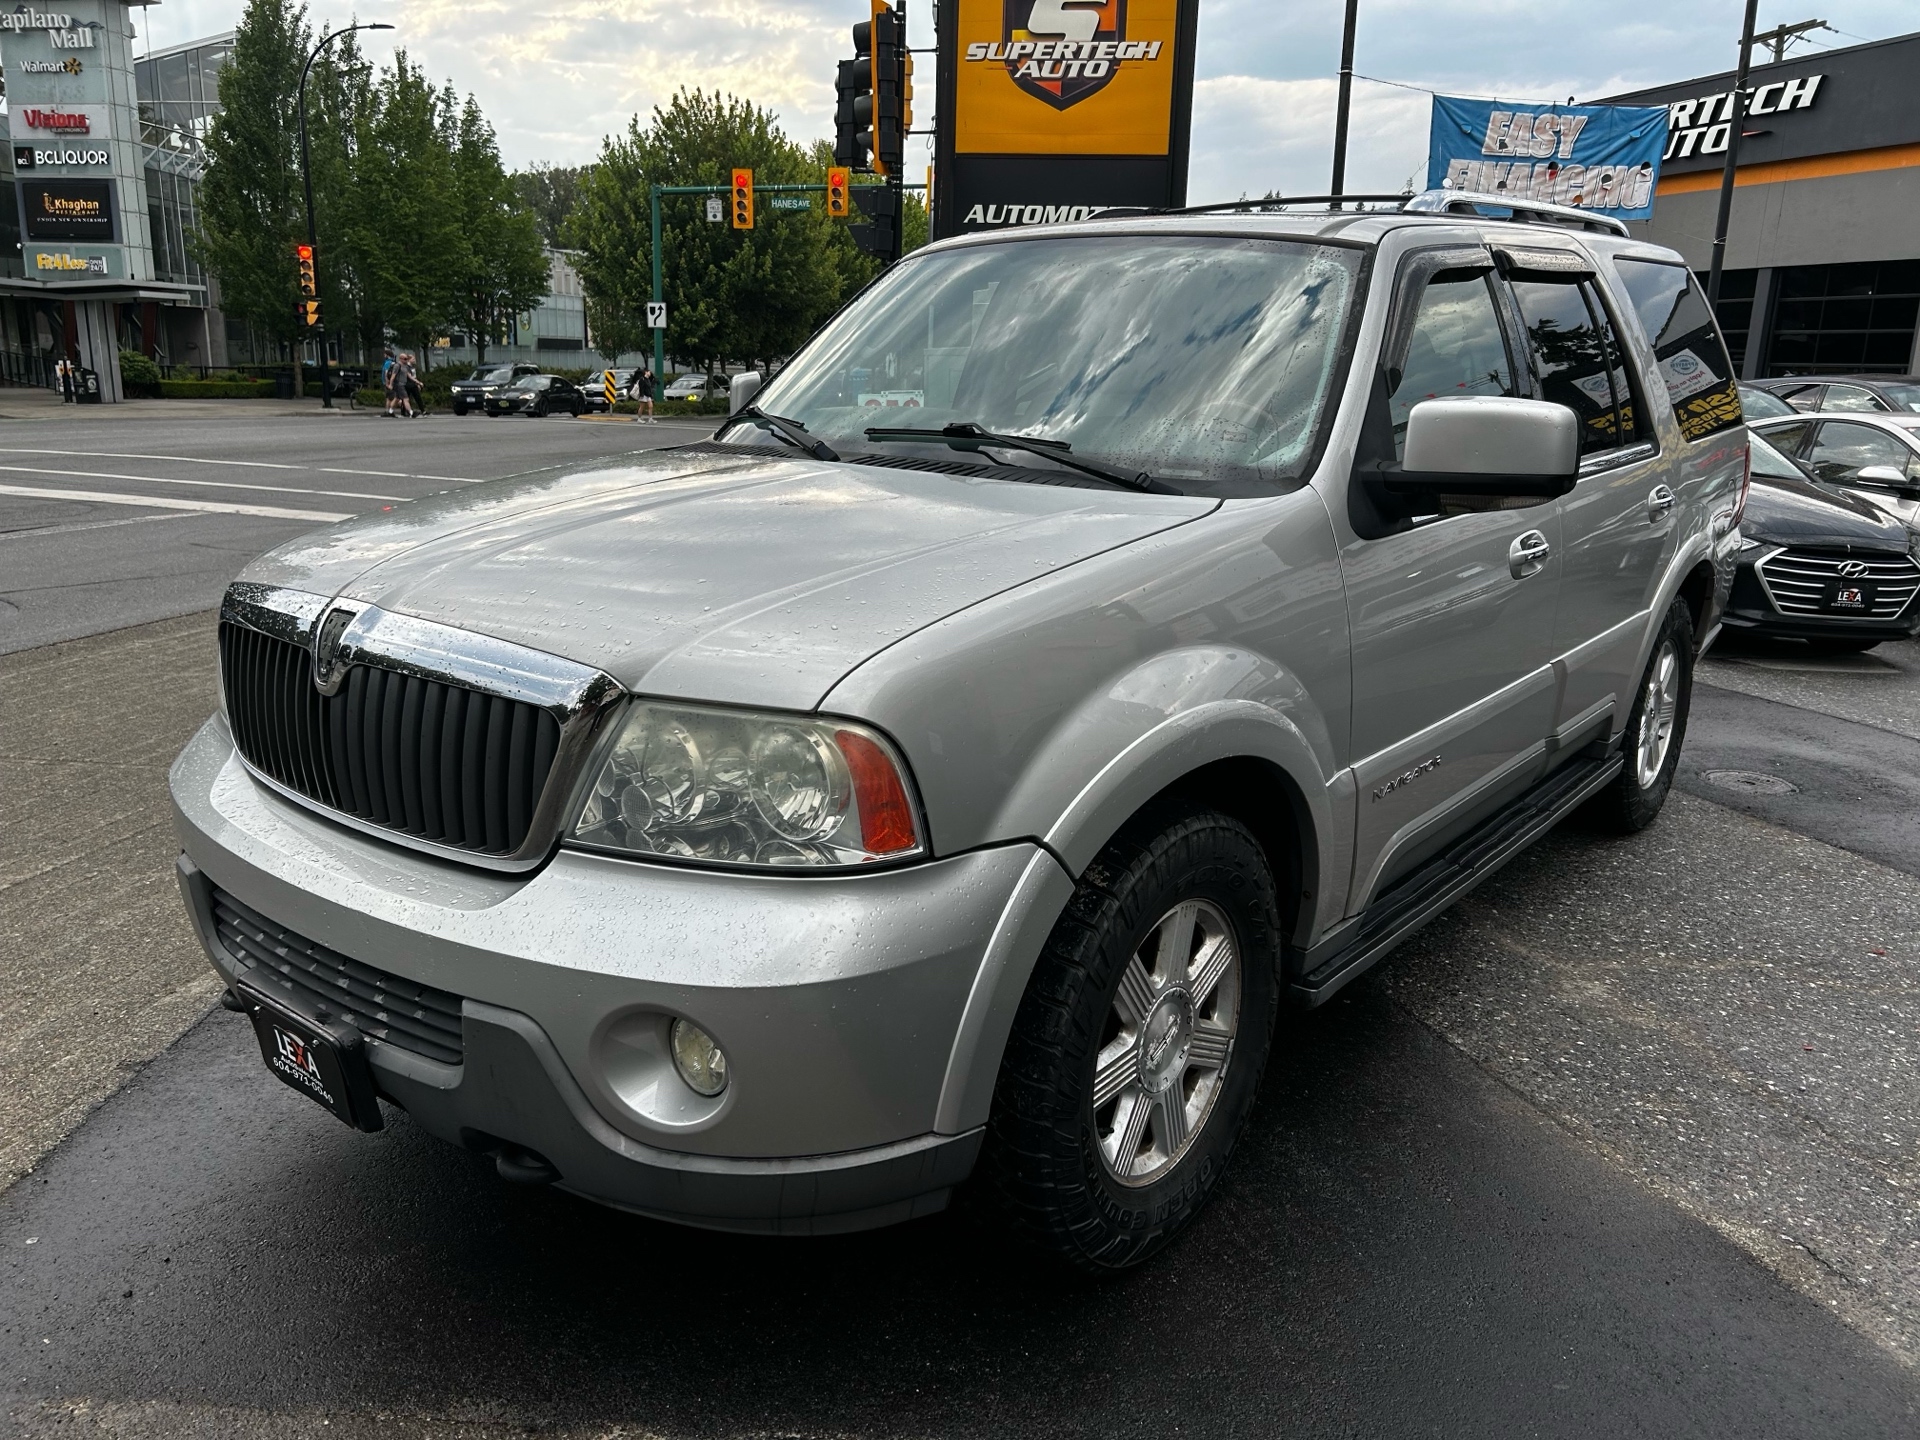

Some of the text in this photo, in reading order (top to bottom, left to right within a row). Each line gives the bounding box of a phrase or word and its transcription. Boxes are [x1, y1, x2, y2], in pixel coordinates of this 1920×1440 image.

[47, 27, 95, 49] Mall
[965, 40, 1162, 61] SUPERTECH
[20, 60, 66, 73] Walmart
[1013, 60, 1109, 79] AUTO
[1482, 110, 1588, 160] EASY
[54, 198, 100, 211] Khaghan
[771, 199, 811, 209] HANES AVE
[963, 203, 1140, 225] AUTOMO
[1837, 590, 1862, 602] LEXA
[1372, 754, 1443, 803] NAVIGATOR
[274, 1028, 322, 1080] LEXA
[273, 1056, 334, 1104] 604-971-0040
